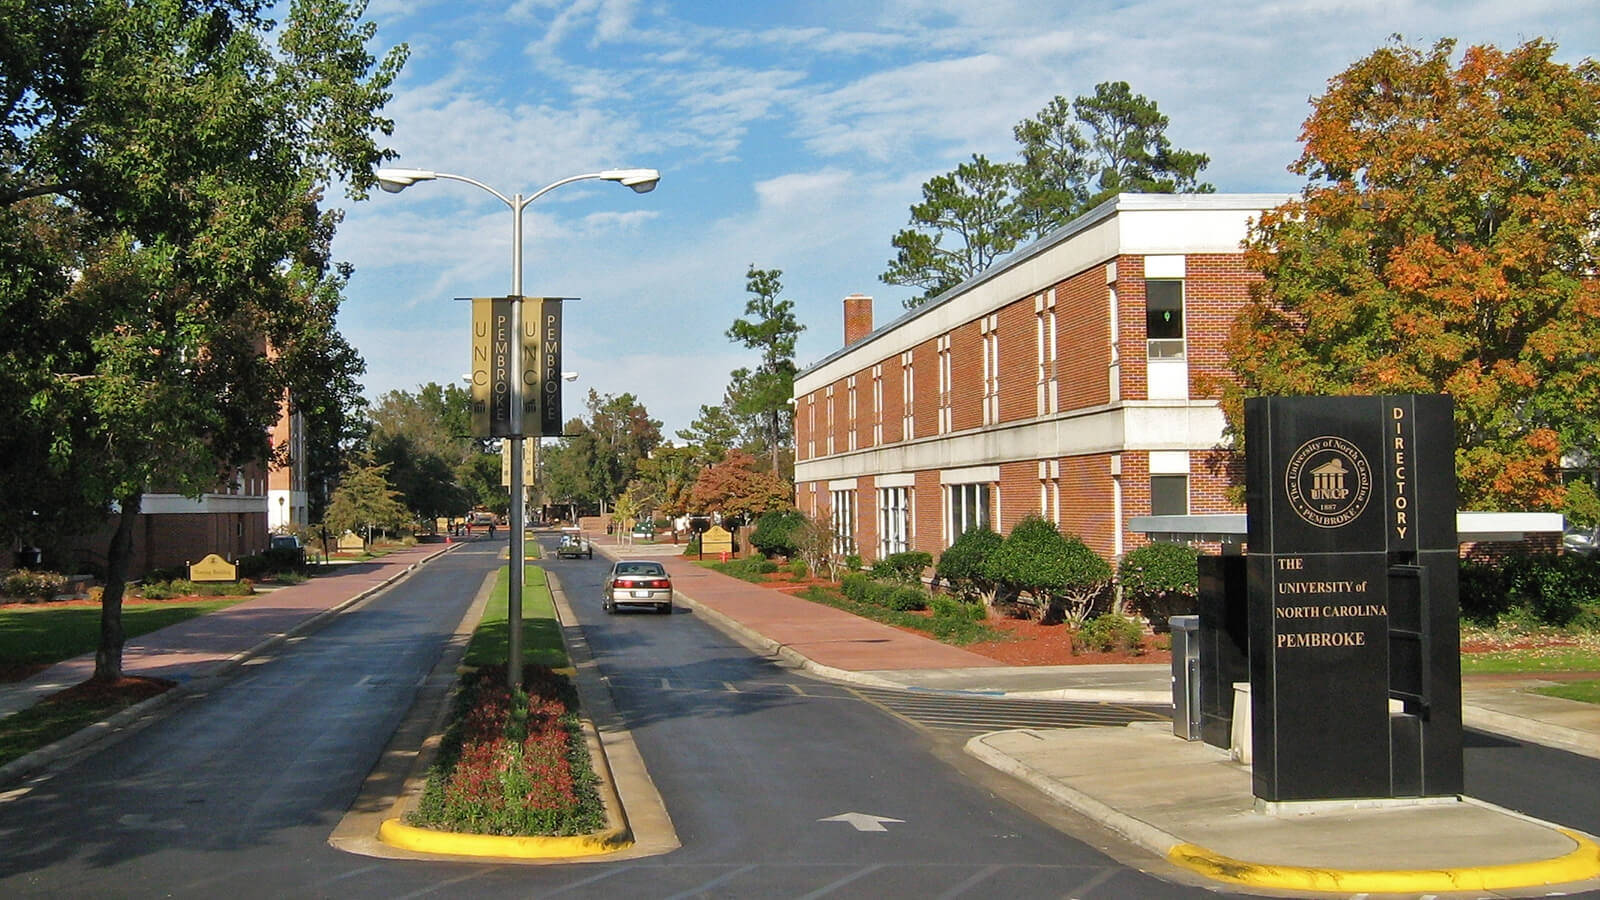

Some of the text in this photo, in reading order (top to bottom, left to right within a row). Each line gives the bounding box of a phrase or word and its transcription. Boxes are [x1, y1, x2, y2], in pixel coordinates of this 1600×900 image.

[473, 321, 488, 386] UNC
[495, 315, 508, 421] PEMBROKE
[523, 321, 538, 386] UNC
[545, 315, 558, 420] PEMBROKE
[1289, 439, 1369, 502] The University of North Carolina
[1393, 407, 1407, 540] DIRECTORY
[1311, 488, 1350, 500] UNCP
[1302, 507, 1357, 525] PEMBROKE
[1277, 558, 1303, 570] THE
[1278, 581, 1368, 594] UNIVERSITY of
[1276, 604, 1388, 619] NORTH CAROLINA
[1277, 631, 1366, 648] PEMBROKE
